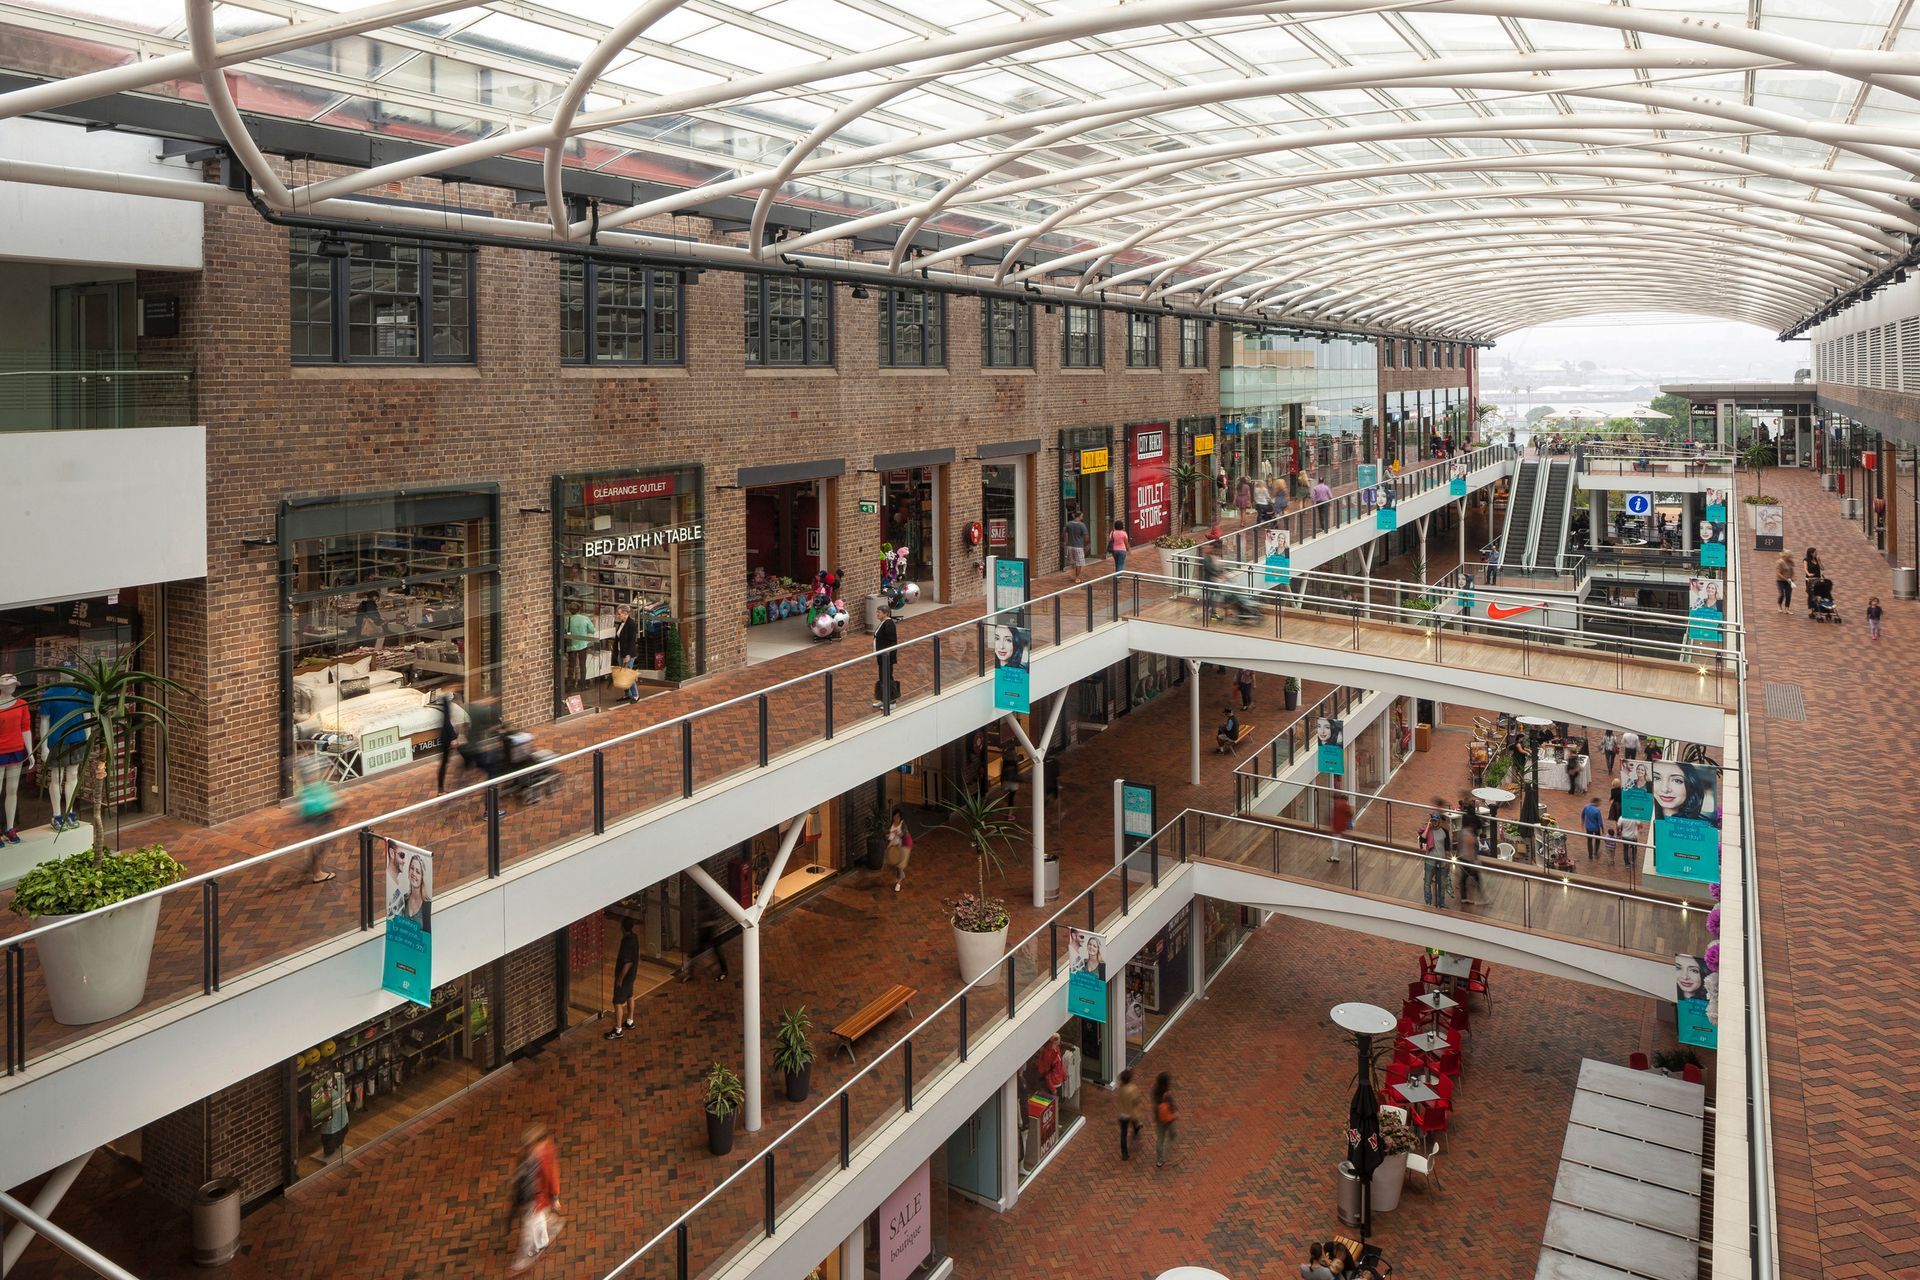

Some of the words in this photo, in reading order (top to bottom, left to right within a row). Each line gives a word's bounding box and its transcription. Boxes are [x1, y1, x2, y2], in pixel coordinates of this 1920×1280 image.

[593, 485, 638, 498] CLEARANCE
[639, 482, 667, 493] OUTLET
[1137, 482, 1164, 508] OUTLET
[585, 540, 613, 557] BED
[617, 533, 650, 552] BATH
[654, 531, 662, 547] N
[665, 525, 702, 544] TABLE
[991, 527, 1006, 539] SALE
[889, 1192, 923, 1241] SALE
[890, 1225, 922, 1263] boutique
